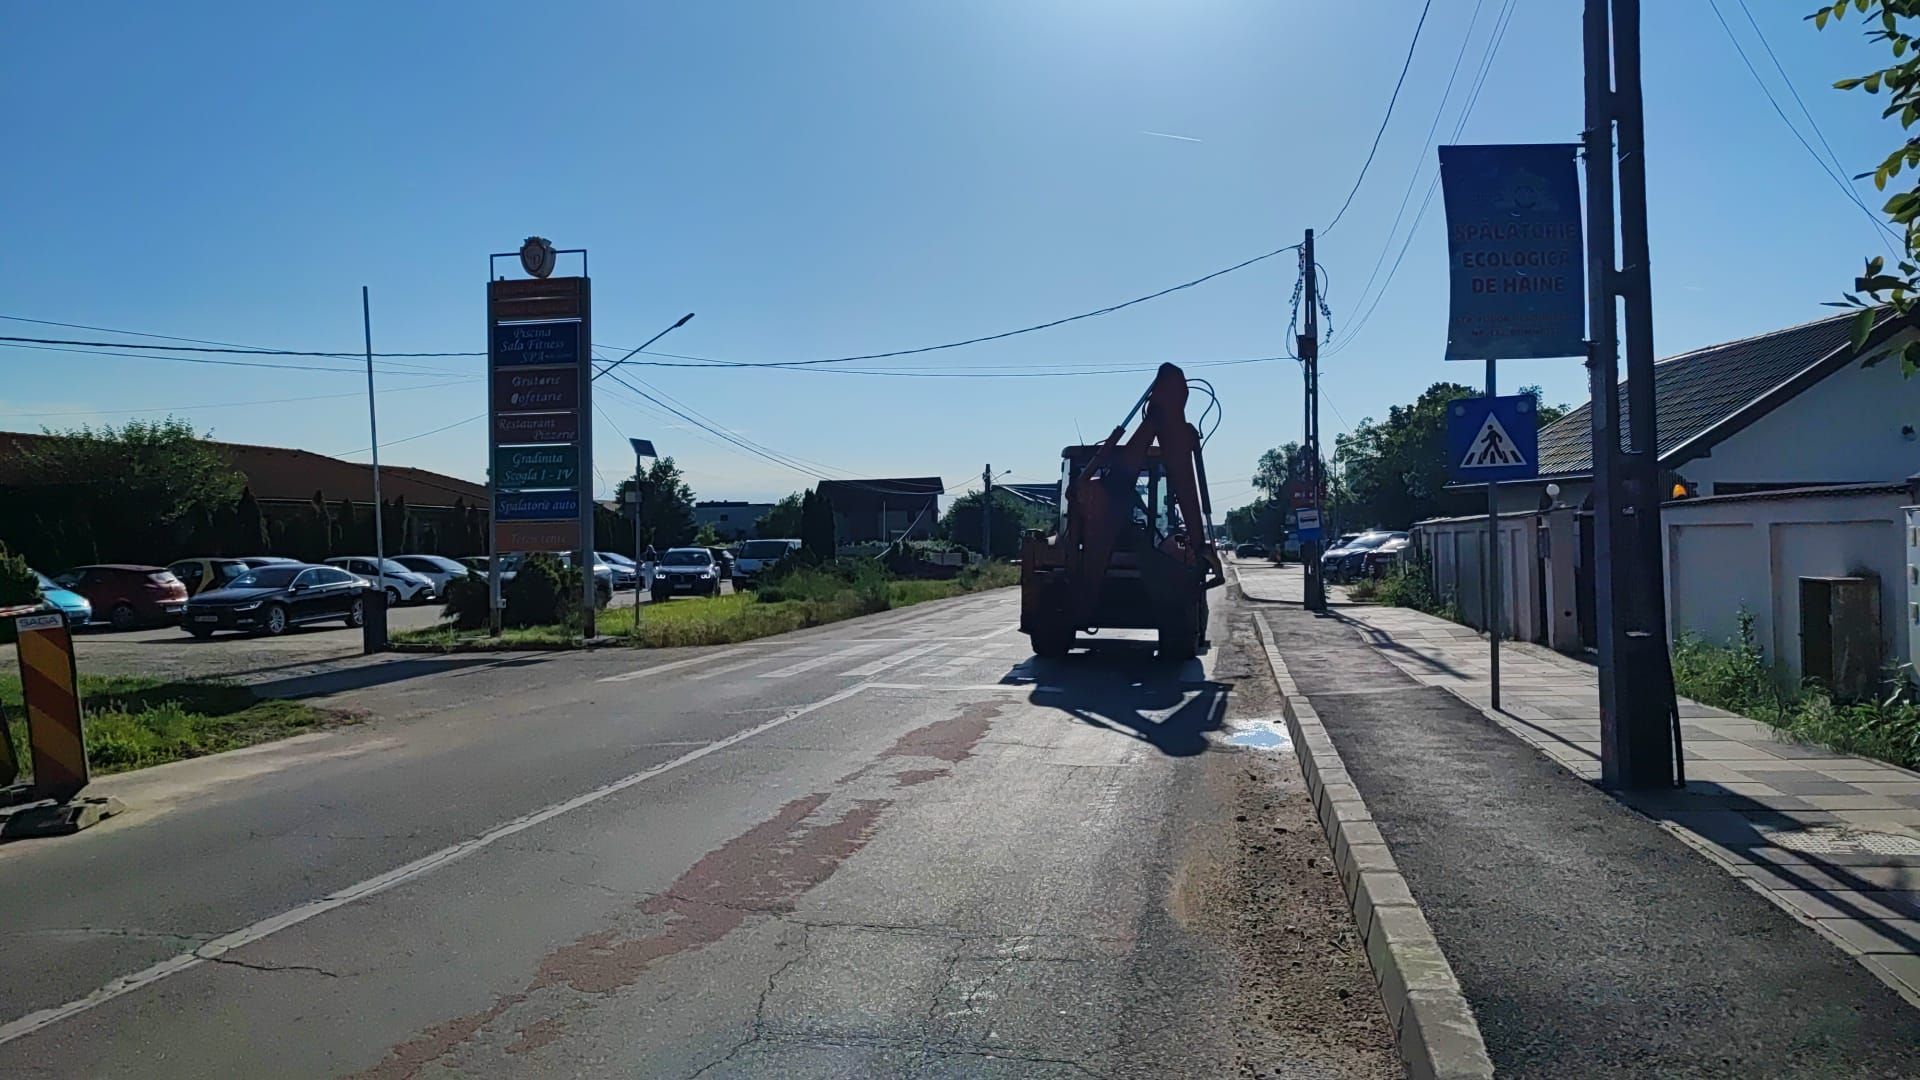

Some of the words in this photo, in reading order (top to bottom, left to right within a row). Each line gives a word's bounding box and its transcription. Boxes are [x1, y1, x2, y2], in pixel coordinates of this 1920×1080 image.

[1472, 278, 1497, 293] DE
[1503, 276, 1566, 294] HAINE
[513, 327, 552, 339] Piscina
[500, 338, 524, 352] Sala
[527, 339, 565, 350] Fitness
[520, 351, 545, 364] SPA
[498, 417, 556, 429] Restaurant
[556, 468, 575, 481] IV
[498, 498, 550, 514] Spalatorie
[552, 499, 576, 511] auto
[19, 617, 58, 627] SAGA
